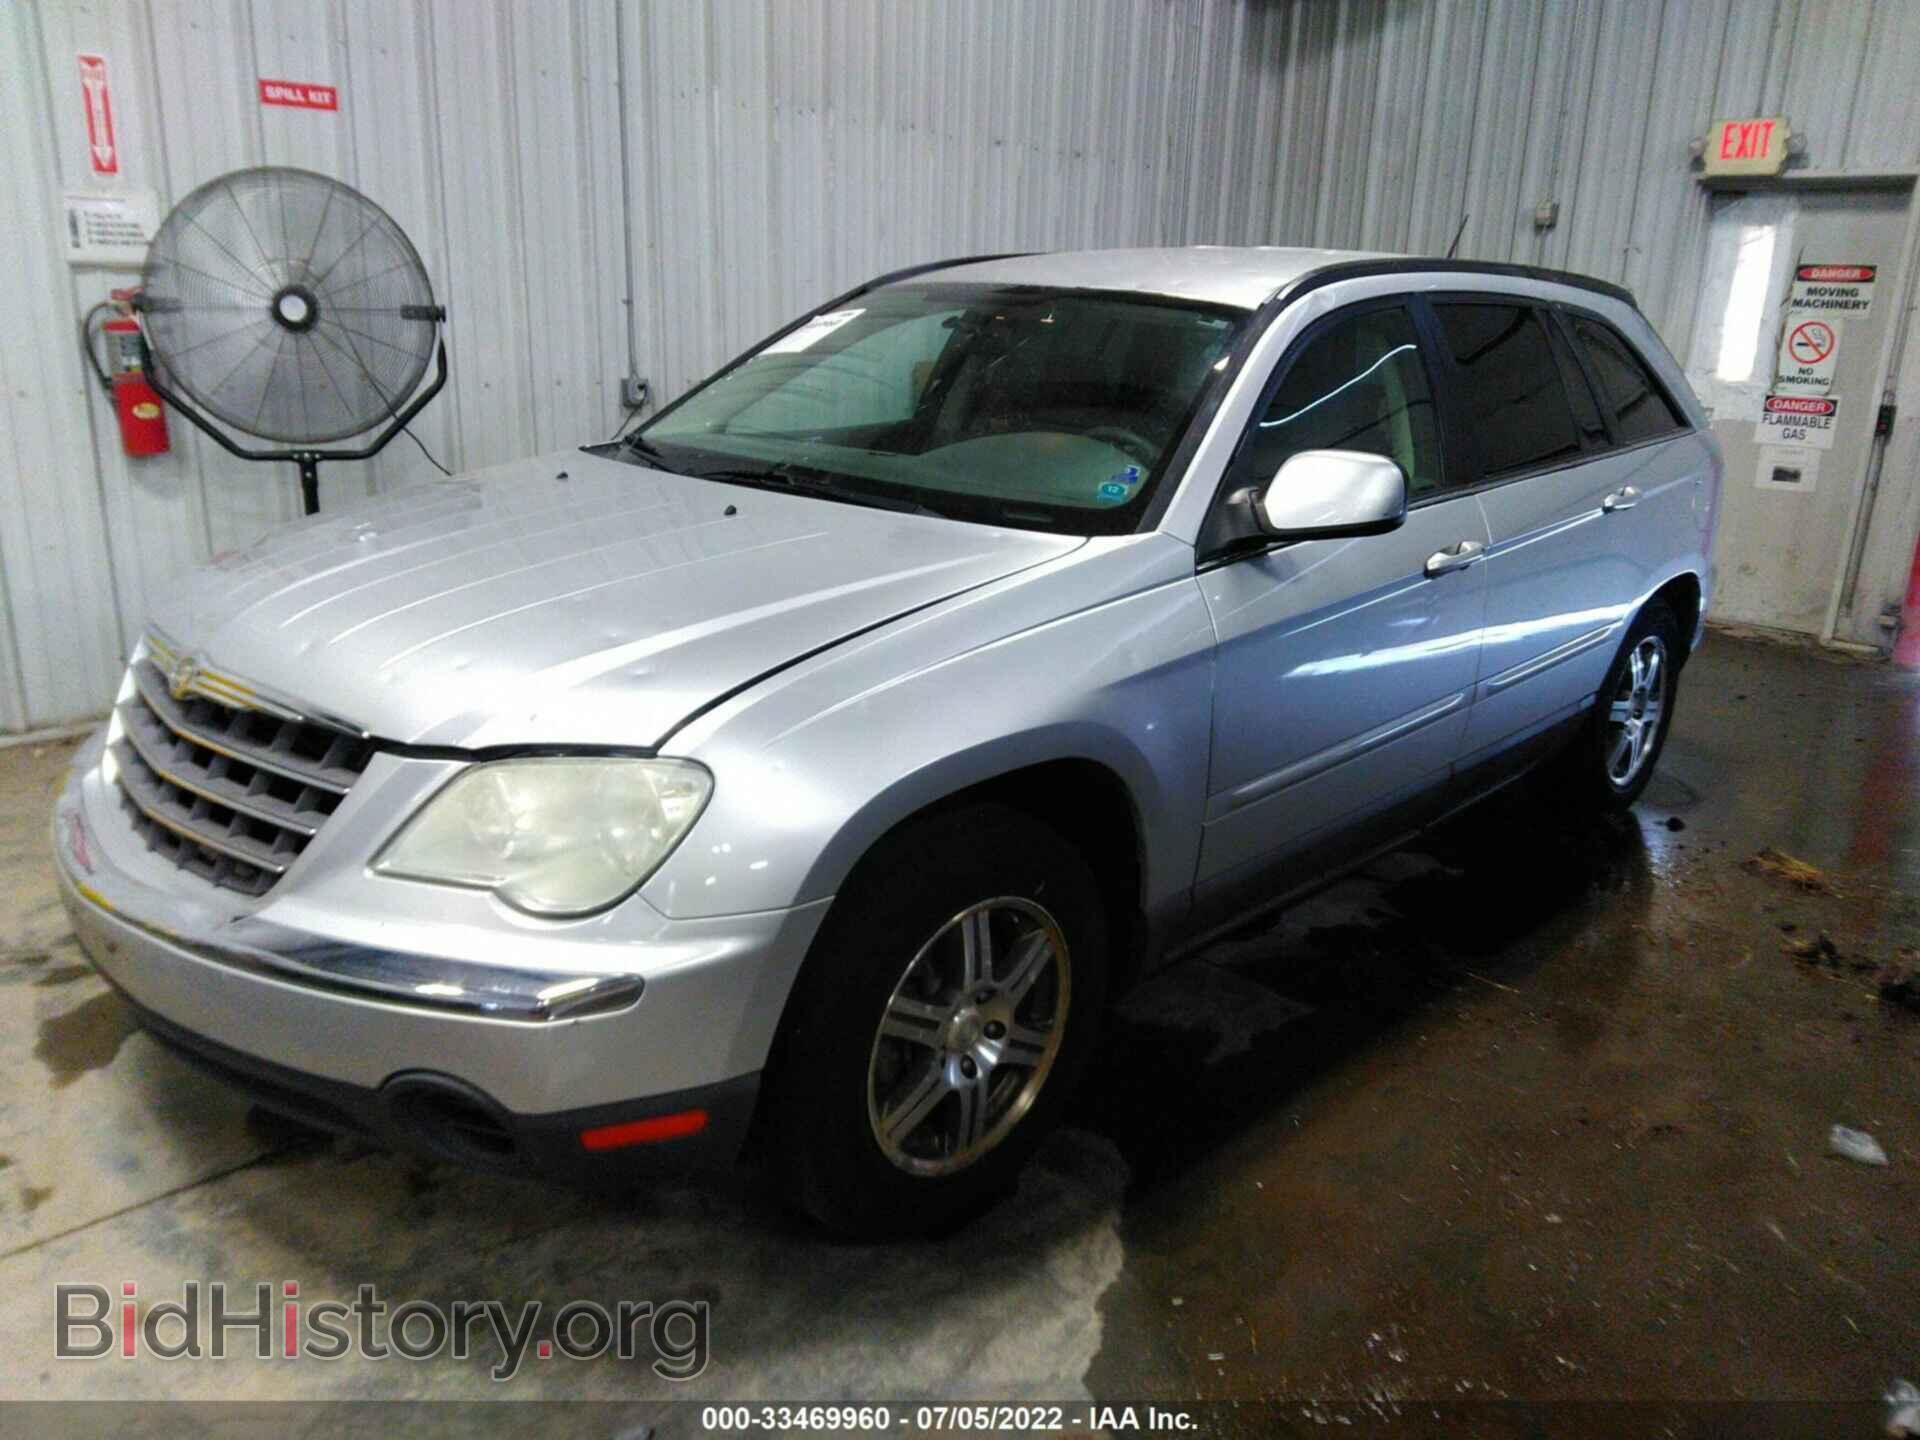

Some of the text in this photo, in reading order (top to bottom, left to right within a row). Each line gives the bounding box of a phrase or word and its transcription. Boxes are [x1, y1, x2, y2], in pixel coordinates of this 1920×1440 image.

[265, 84, 332, 103] SPILL KIT
[1720, 120, 1775, 160] EXIT
[1811, 267, 1860, 279] DANGER
[1806, 286, 1859, 297] MOVING
[1791, 298, 1870, 310] MACHINERY
[1797, 367, 1814, 376] NO
[1779, 375, 1830, 386] SMOKING
[1774, 400, 1826, 413] DANGER
[1762, 413, 1832, 430] FLAMMABLE
[1782, 427, 1807, 441] GAS
